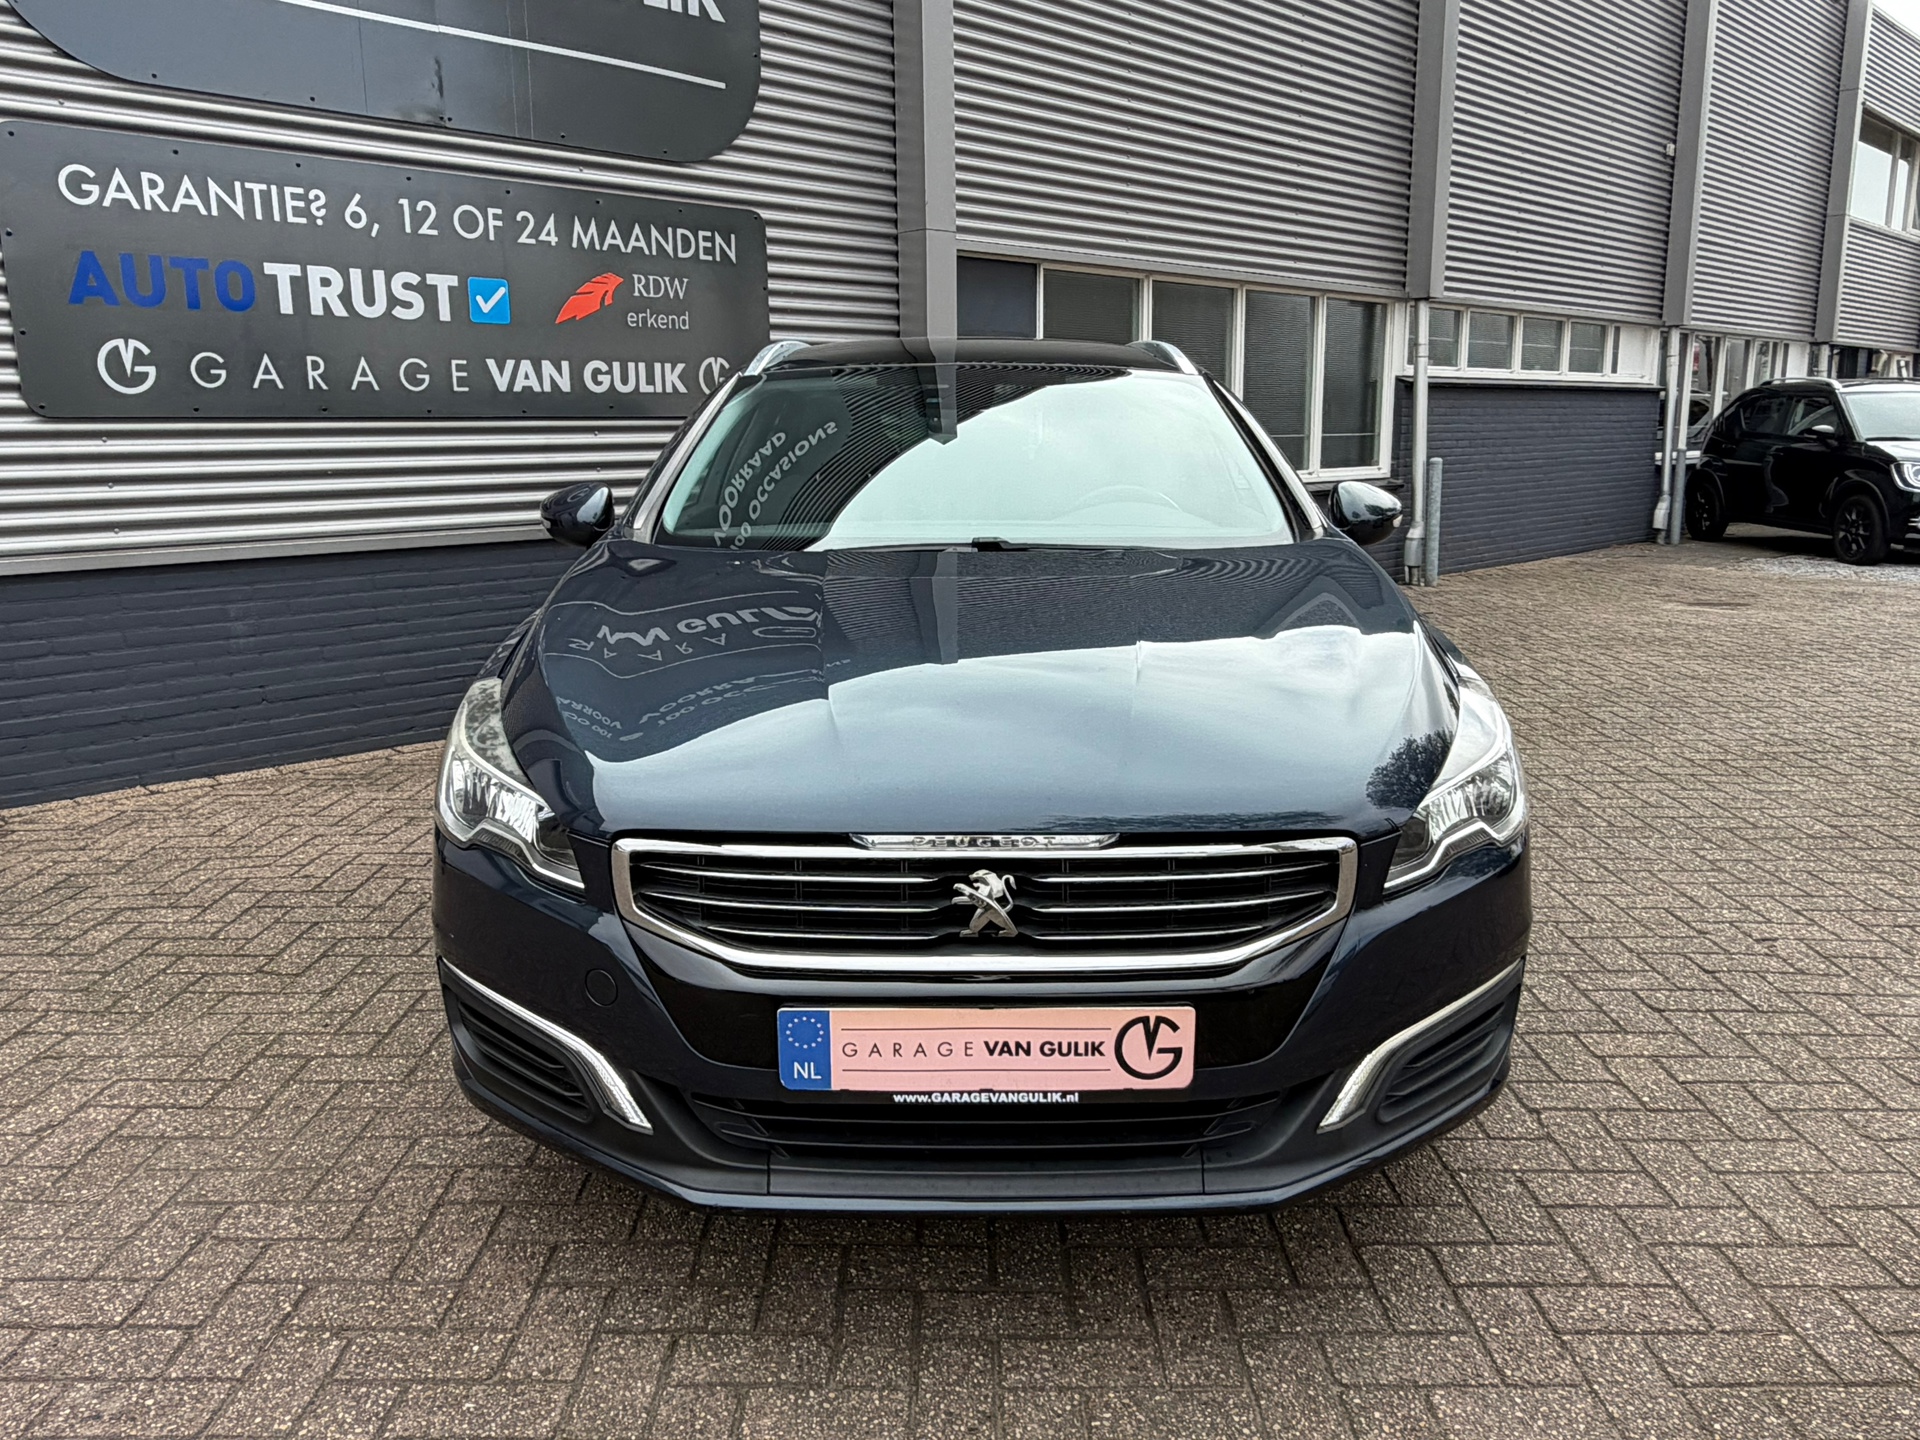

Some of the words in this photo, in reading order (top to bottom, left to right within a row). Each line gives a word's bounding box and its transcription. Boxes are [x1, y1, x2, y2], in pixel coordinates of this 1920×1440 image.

[57, 163, 327, 226] GARANTIE?
[344, 193, 380, 238] 6,
[398, 198, 439, 236] 12
[453, 204, 503, 242] OF
[516, 210, 559, 247] 24
[572, 215, 738, 265] MAANDEN
[632, 273, 690, 300] RDW
[626, 308, 690, 330] erkend
[190, 351, 470, 392] GARAGE
[485, 358, 572, 393] VAN
[583, 360, 689, 394] GULIK
[912, 836, 1056, 848] PEUGEOT
[842, 1041, 974, 1058] GARAGE
[984, 1040, 1031, 1057] VAN
[1039, 1040, 1106, 1058] GULIK
[793, 1061, 822, 1080] NL
[893, 1092, 1080, 1104] www.GARAGEVANGULIK.nl
